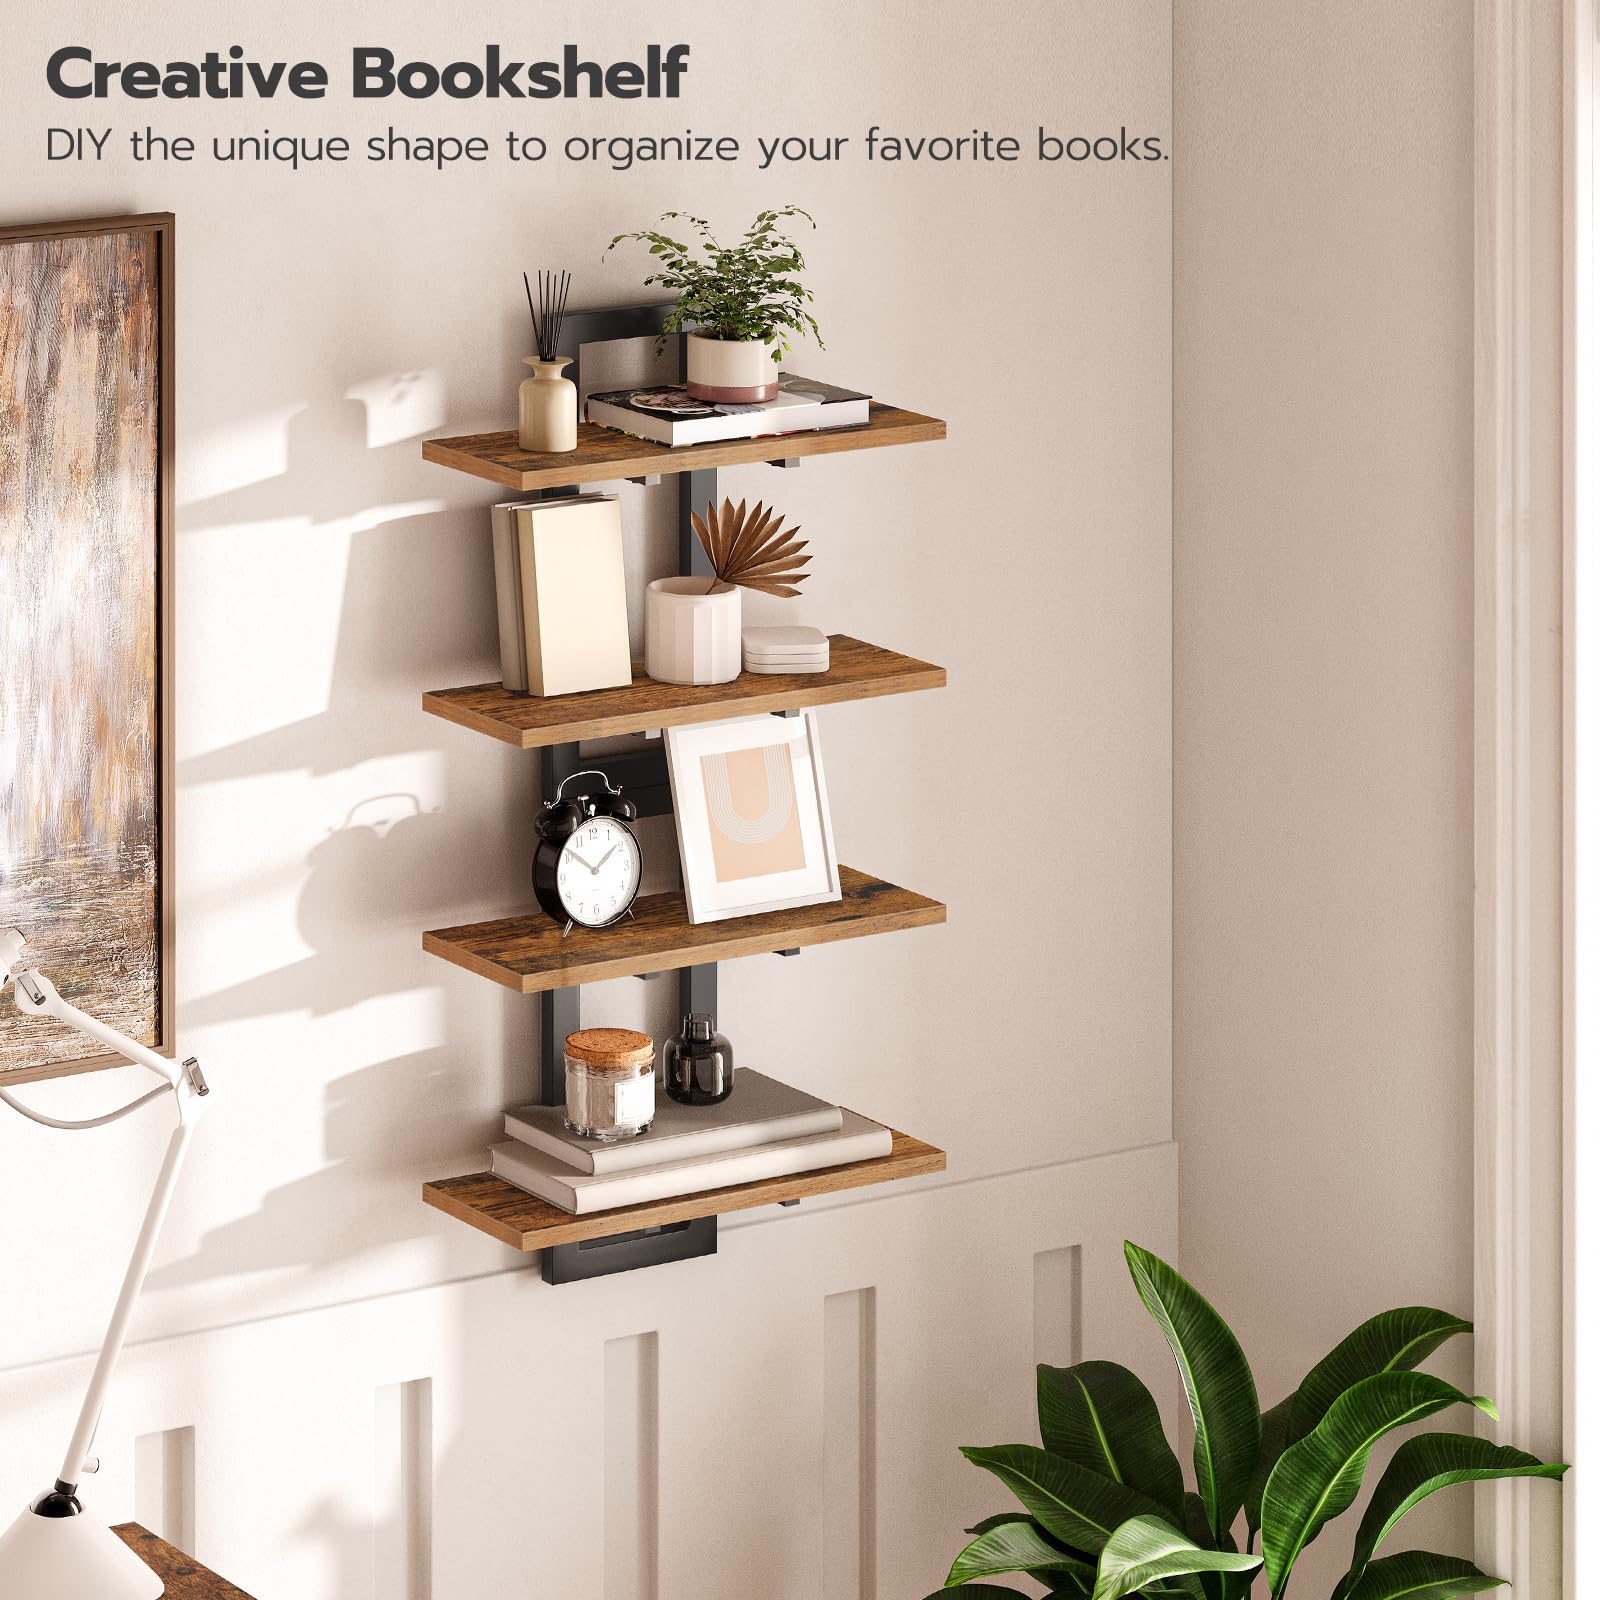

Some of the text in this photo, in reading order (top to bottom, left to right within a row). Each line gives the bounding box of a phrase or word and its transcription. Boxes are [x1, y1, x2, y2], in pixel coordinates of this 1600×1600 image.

[588, 827, 598, 841] 12
[575, 835, 583, 848] 11
[617, 840, 624, 852] 2
[623, 859, 630, 871] 3
[559, 873, 566, 885] 9
[619, 879, 625, 890] 4
[565, 890, 572, 903] 8
[610, 895, 617, 907] 5
[578, 902, 584, 914] 7
[593, 903, 600, 915] 6
